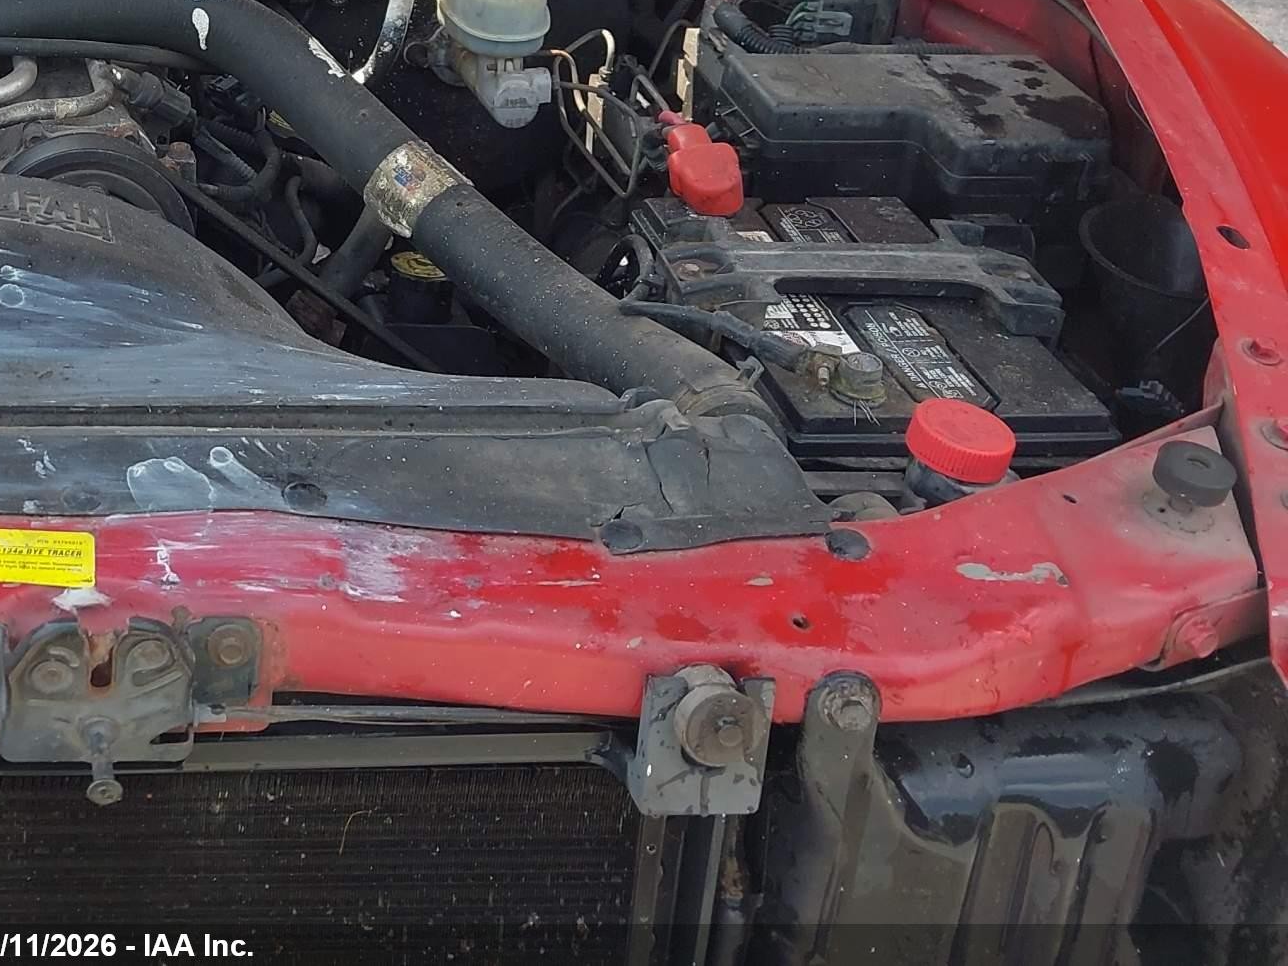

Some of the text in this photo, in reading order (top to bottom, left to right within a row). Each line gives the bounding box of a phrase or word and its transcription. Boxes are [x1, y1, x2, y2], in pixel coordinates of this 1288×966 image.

[865, 322, 891, 352] POISON
[891, 355, 919, 383] DANGER
[47, 549, 82, 558] TRACER
